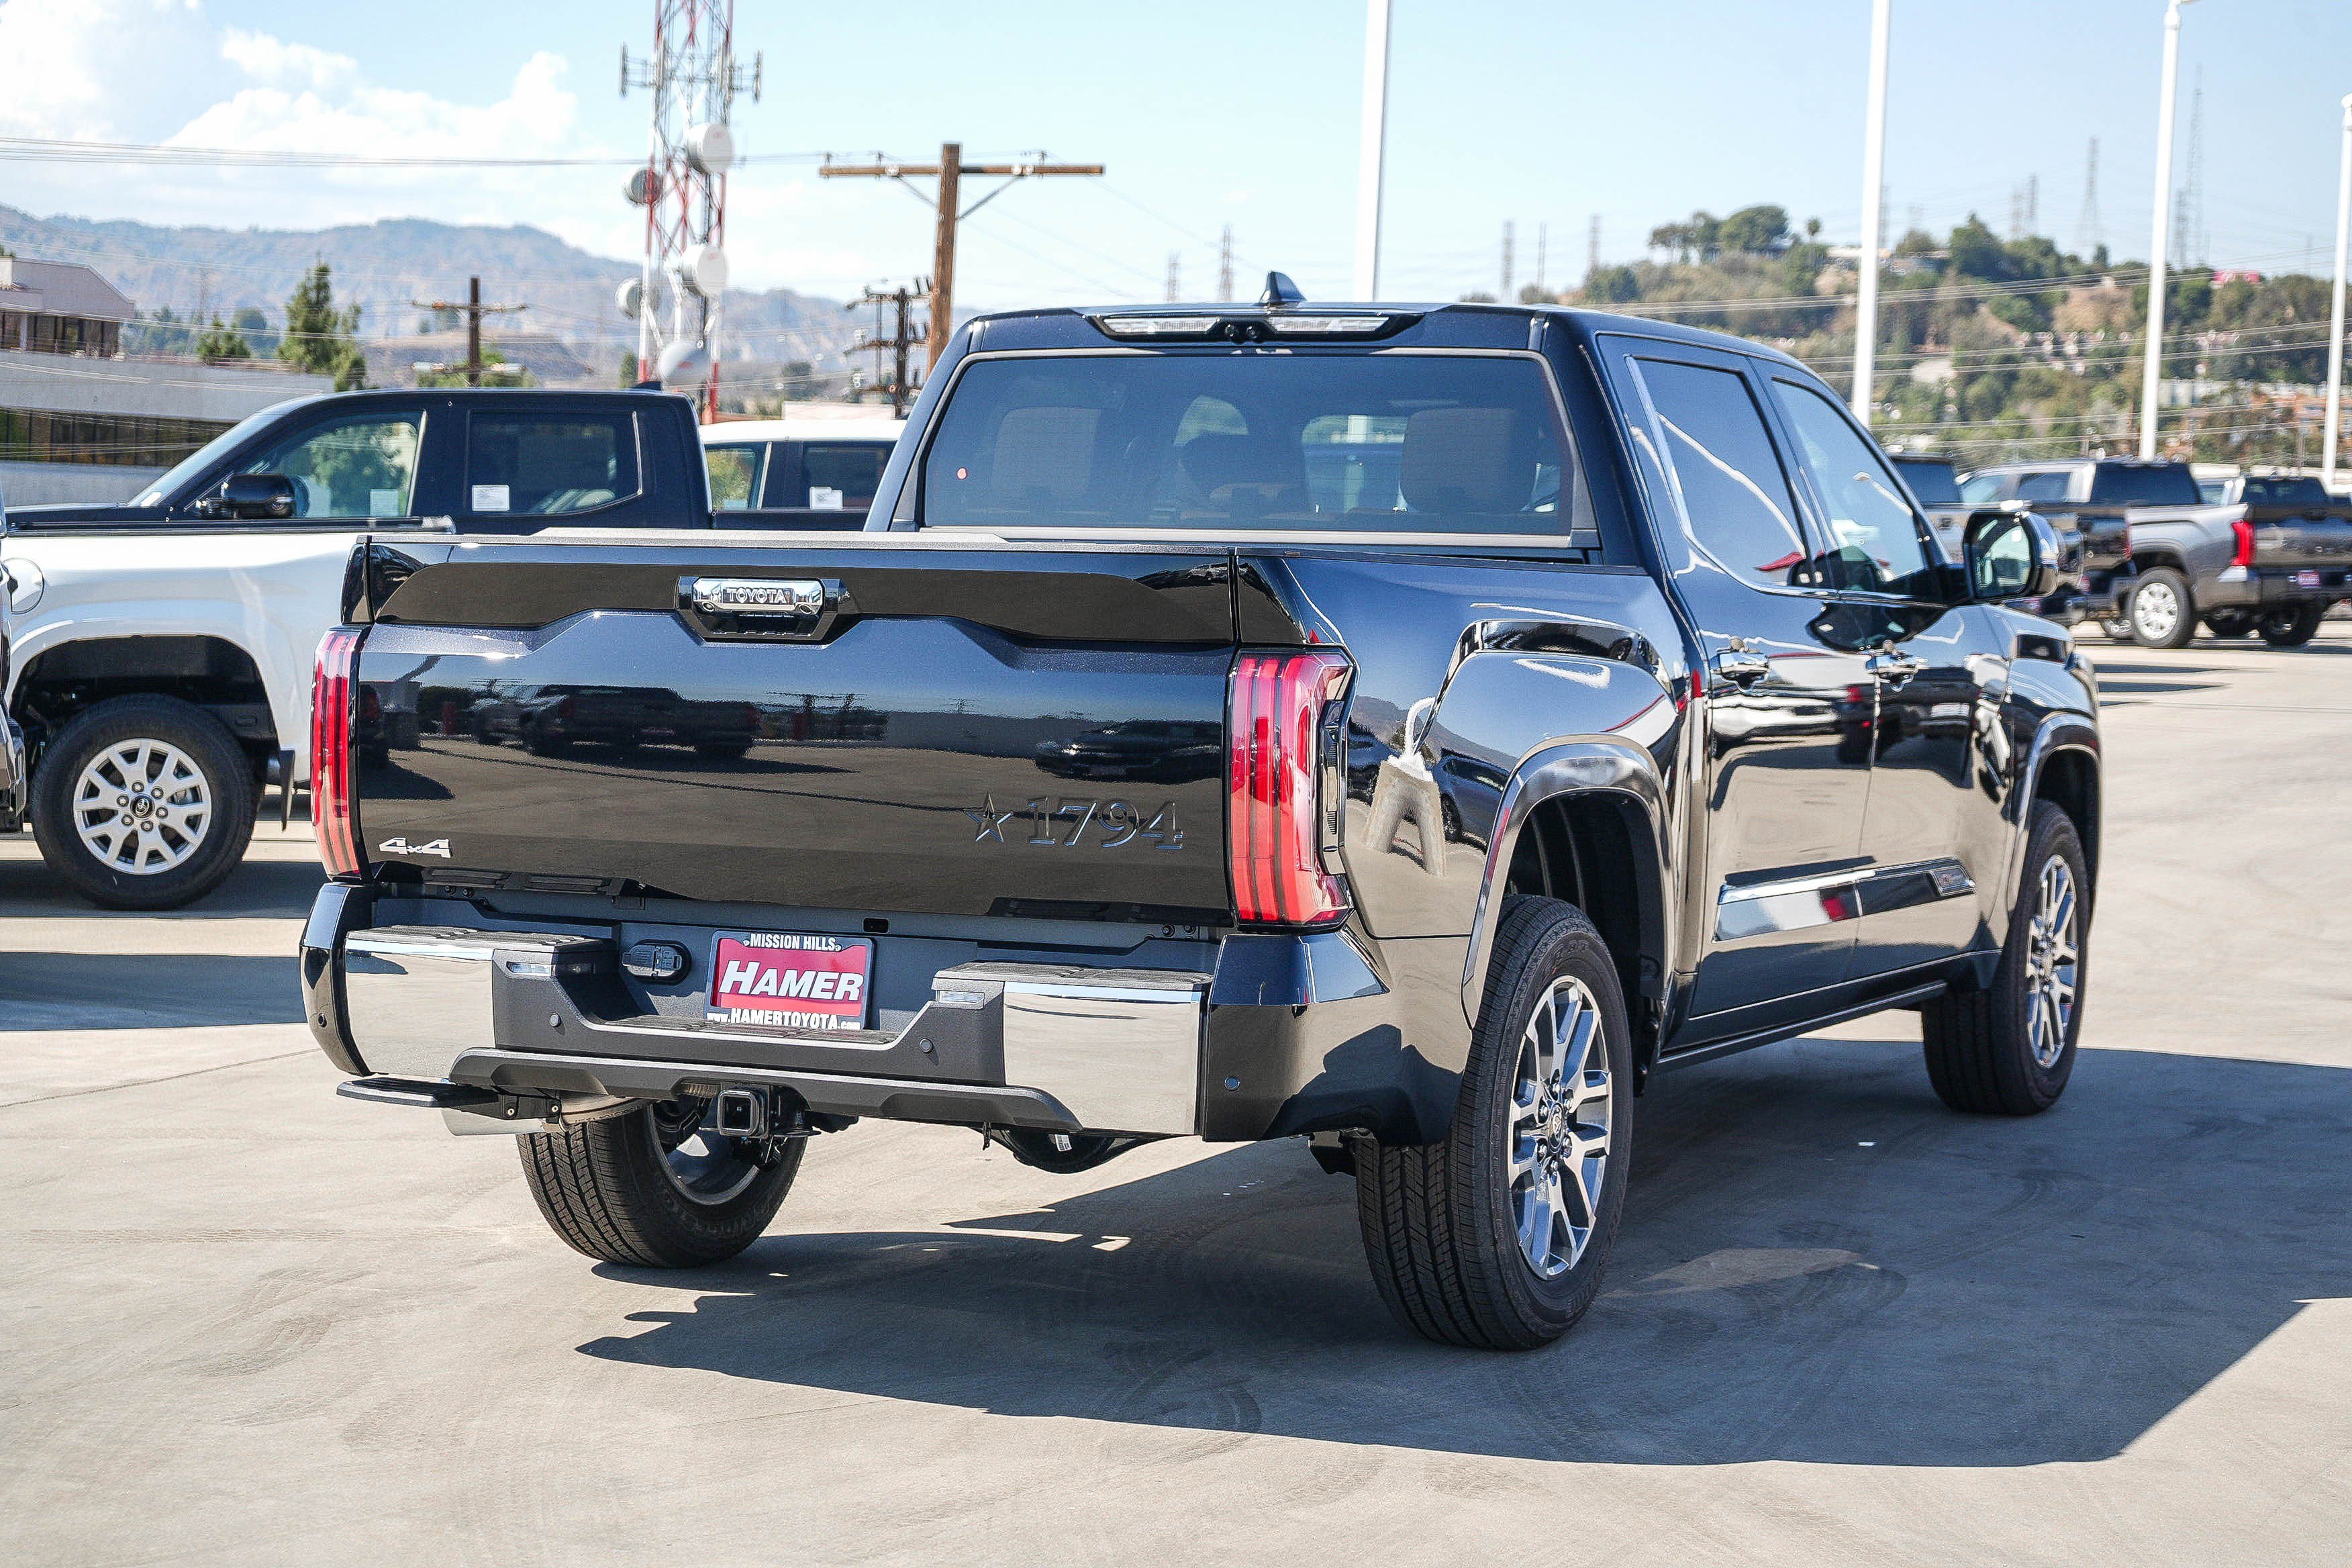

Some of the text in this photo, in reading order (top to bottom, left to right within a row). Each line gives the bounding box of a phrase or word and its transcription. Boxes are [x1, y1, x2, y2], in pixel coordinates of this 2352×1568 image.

[726, 587, 787, 604] TOYOTA
[1028, 795, 1184, 850] 1794
[750, 933, 836, 951] MISSION HILLS
[718, 959, 865, 1001] HAMER
